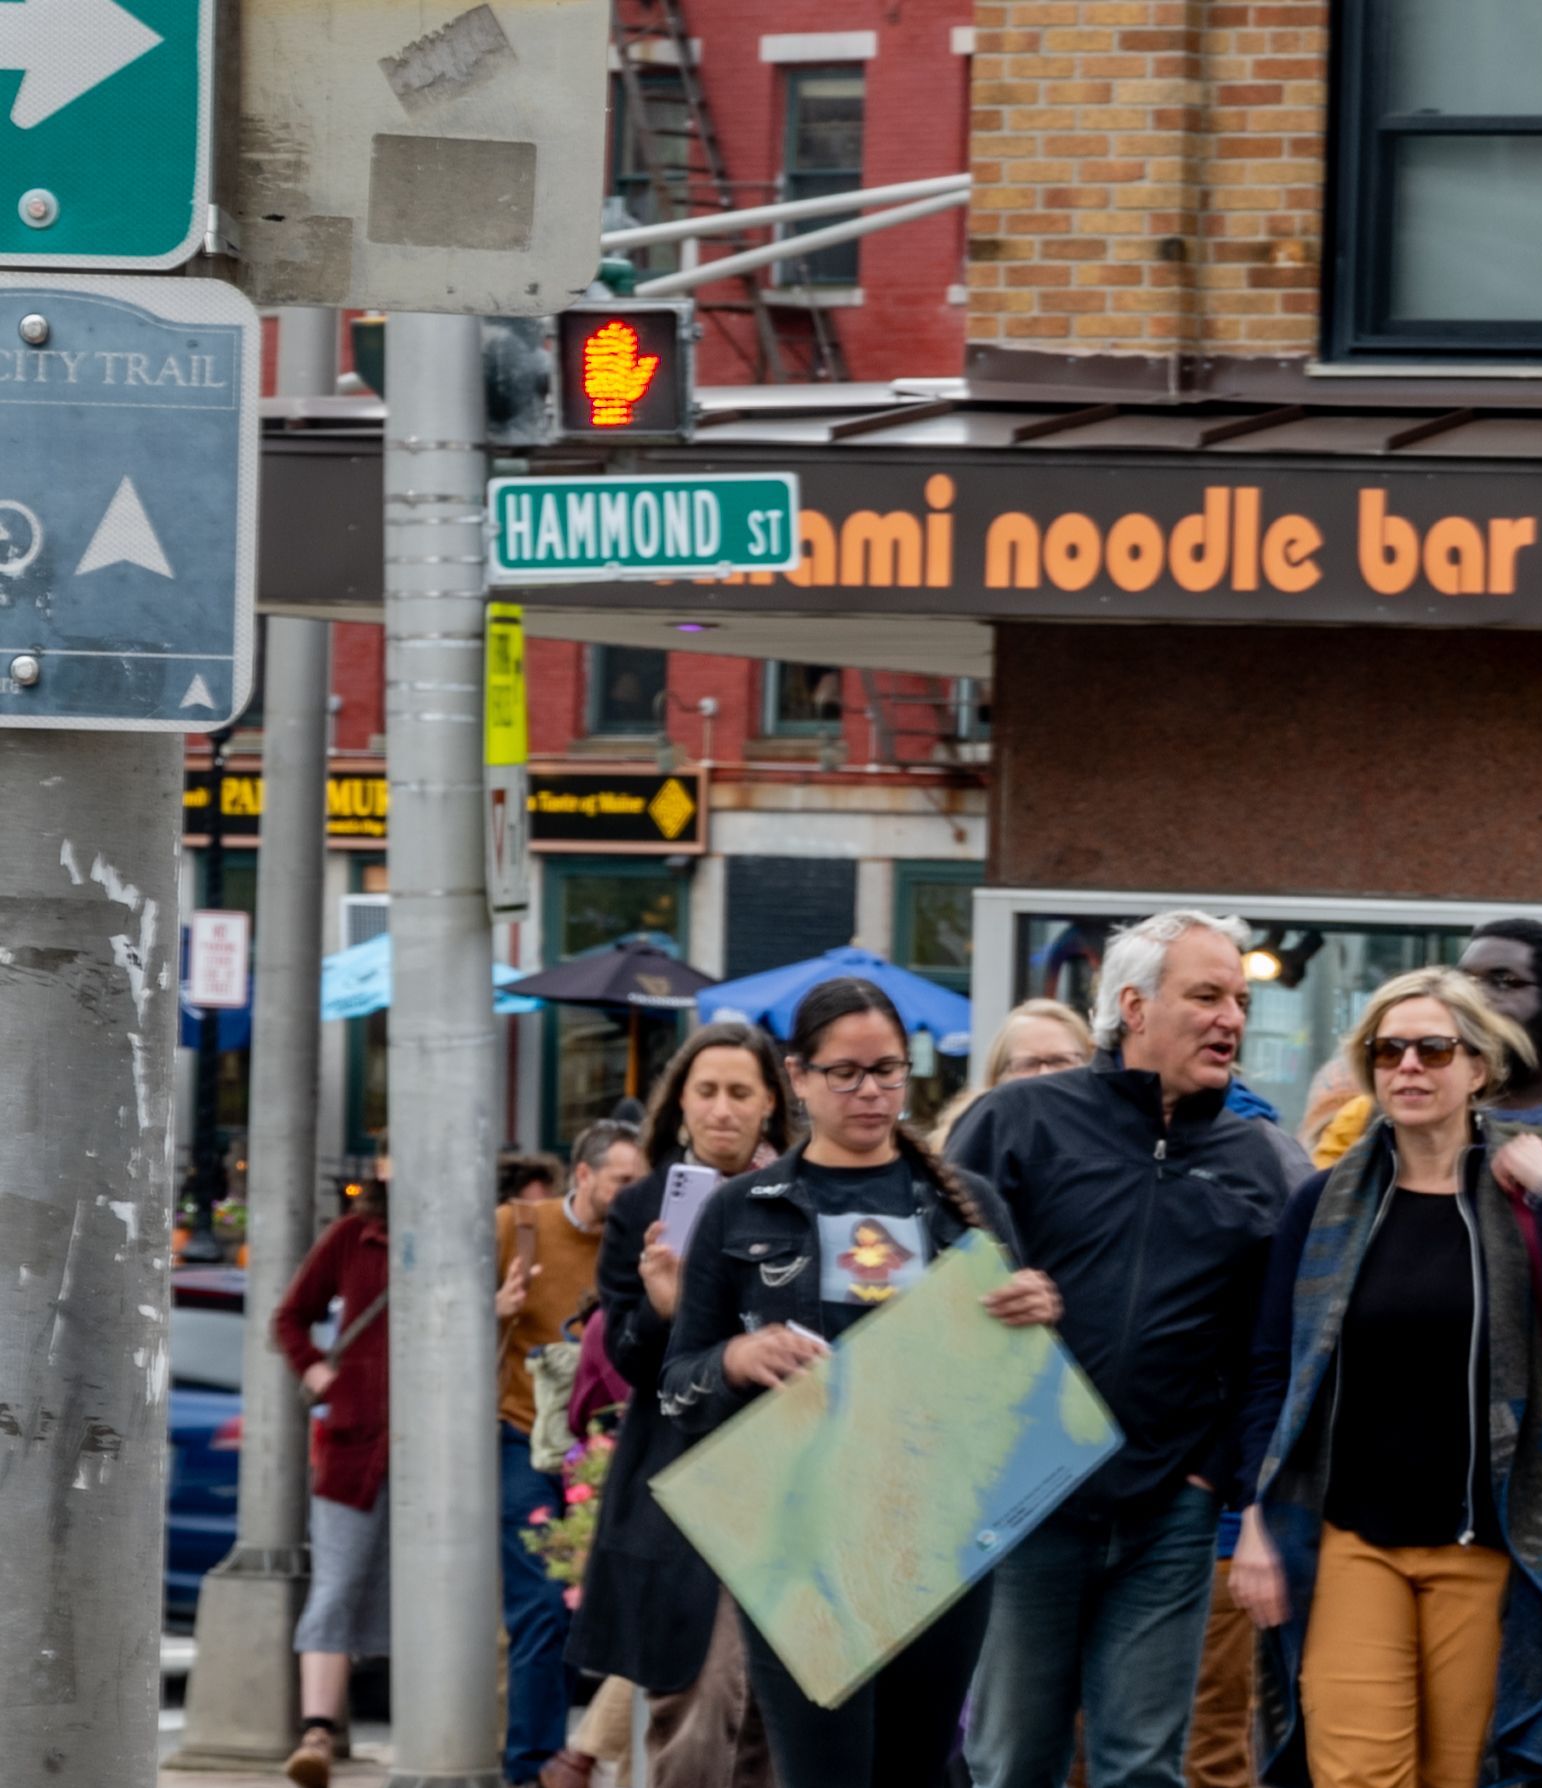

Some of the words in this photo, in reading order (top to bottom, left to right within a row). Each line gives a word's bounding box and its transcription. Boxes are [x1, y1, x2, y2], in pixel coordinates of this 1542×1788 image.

[95, 352, 227, 388] TRAIL
[505, 489, 721, 560] HAMMOND
[747, 508, 784, 556] ST
[653, 473, 955, 588] ami
[985, 486, 1325, 592] noodle
[1357, 488, 1537, 595] bar
